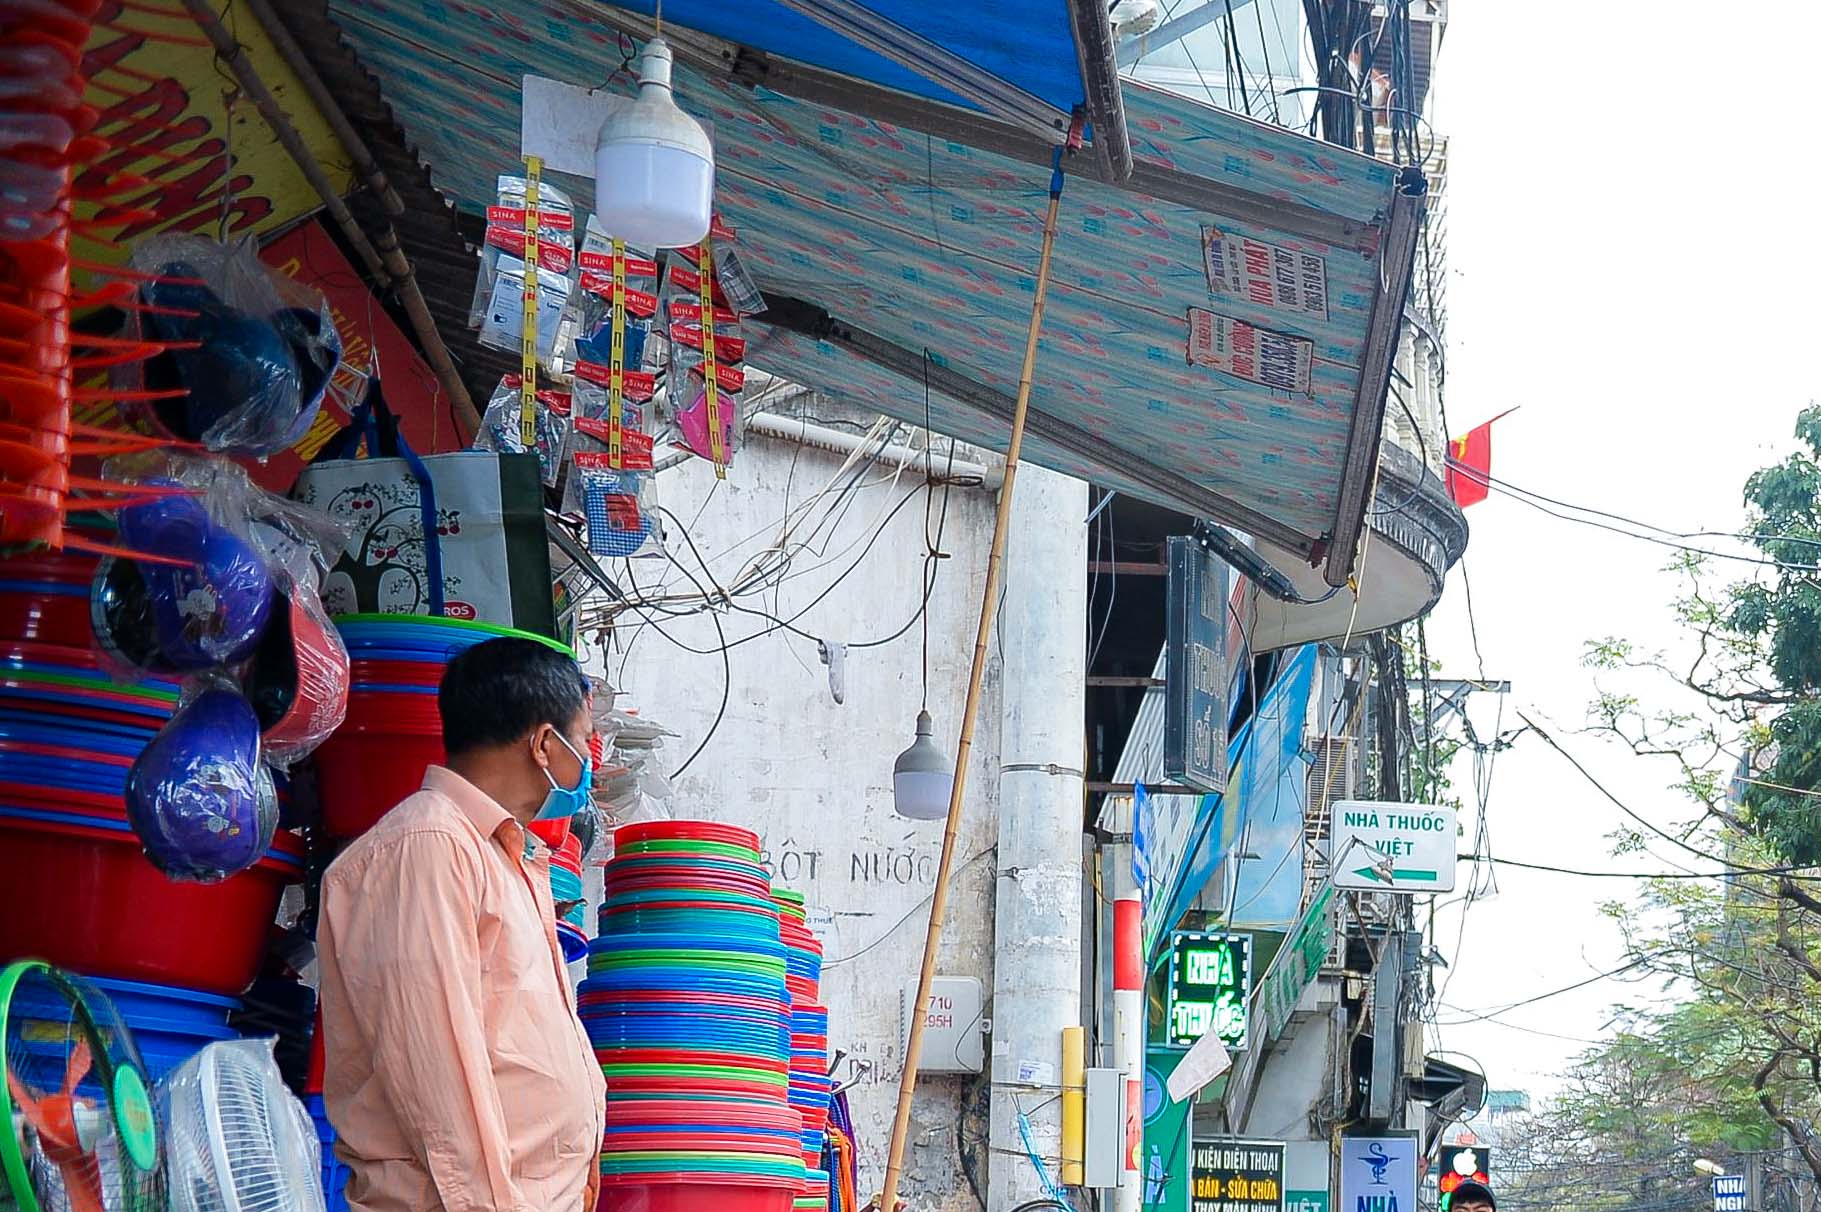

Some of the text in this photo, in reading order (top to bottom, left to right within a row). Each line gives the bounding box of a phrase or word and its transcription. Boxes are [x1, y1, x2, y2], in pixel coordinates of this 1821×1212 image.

[492, 209, 516, 221] SINA
[583, 256, 606, 267] SINA
[631, 293, 652, 308] SINA
[673, 306, 694, 317] SINA
[721, 369, 740, 382] SINA
[628, 378, 651, 391] SINA
[627, 435, 649, 448] SINA
[1344, 811, 1444, 832] NHÀ THUỐC
[1376, 837, 1414, 858] VIỆT
[1198, 1145, 1222, 1173] KIỆN
[1250, 1150, 1278, 1175] THOẠI
[1198, 1176, 1219, 1198] BÁN
[1227, 1174, 1248, 1200] SỬA
[1250, 1179, 1277, 1200] CHỮA
